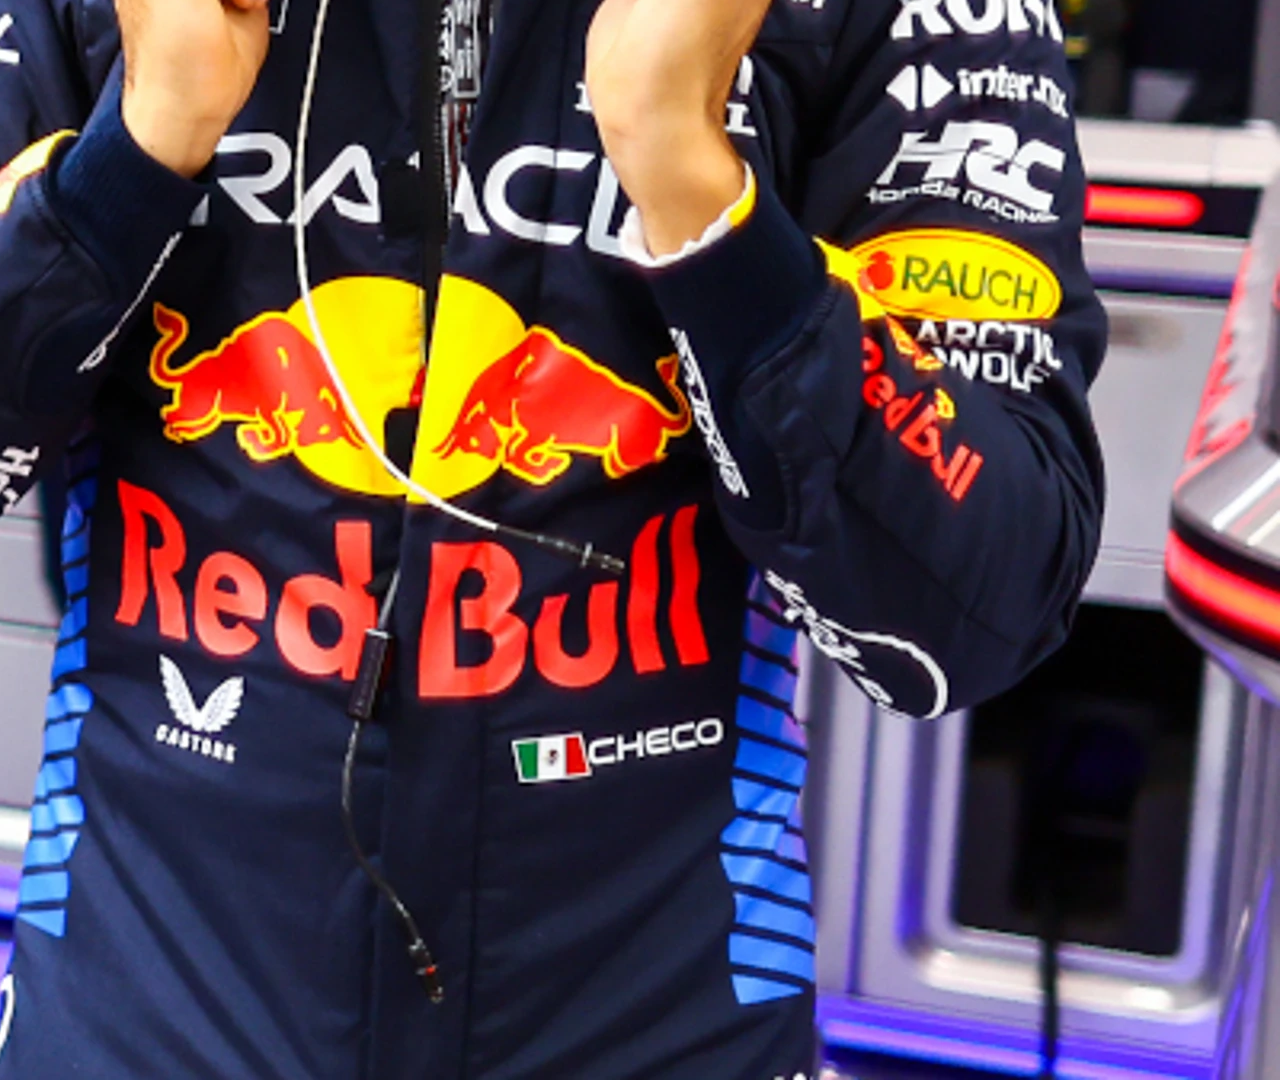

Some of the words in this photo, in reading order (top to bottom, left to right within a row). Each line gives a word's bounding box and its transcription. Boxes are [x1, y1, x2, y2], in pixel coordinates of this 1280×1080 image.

[190, 131, 626, 259] RACL
[901, 254, 1039, 314] RAUCH
[115, 479, 378, 683] Red
[418, 503, 711, 698] Bull
[588, 718, 724, 765] CHECO
